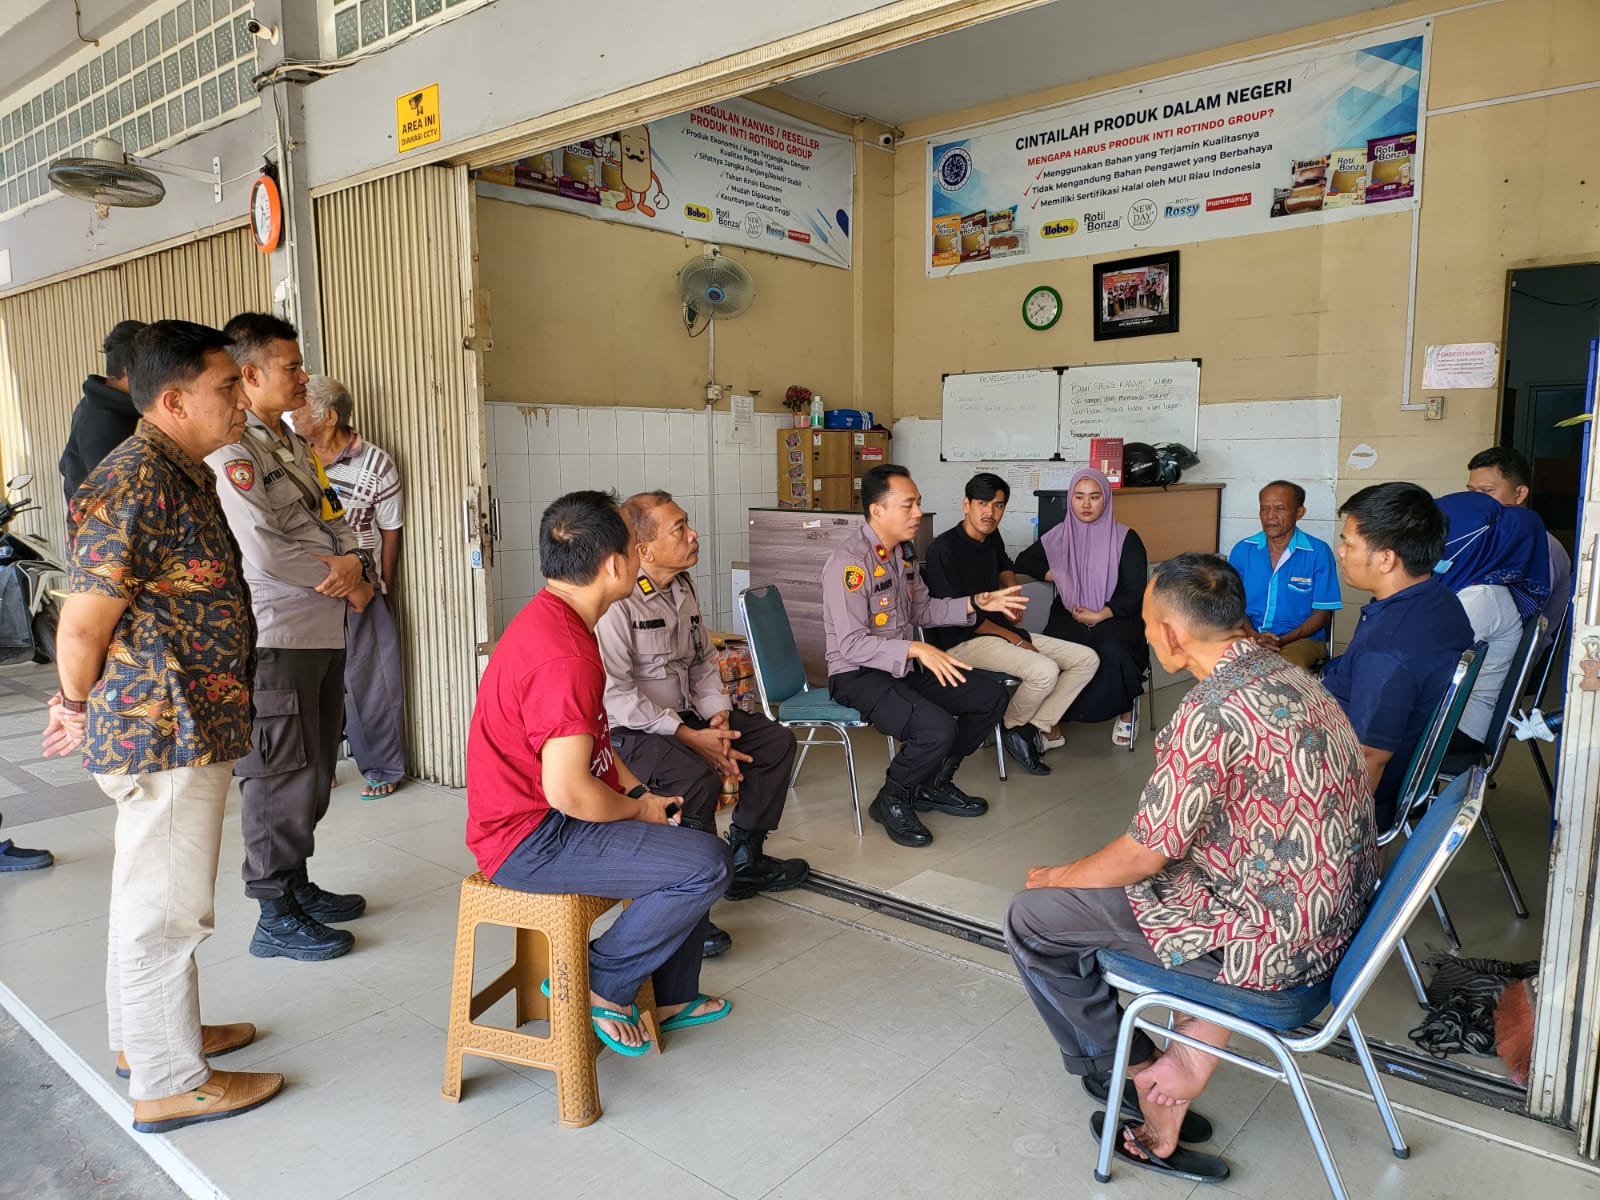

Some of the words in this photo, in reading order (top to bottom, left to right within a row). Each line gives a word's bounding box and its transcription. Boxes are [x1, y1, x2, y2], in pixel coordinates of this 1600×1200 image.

[1015, 122, 1089, 151] CINTAILAH
[1094, 107, 1158, 134] PRODUK
[1163, 93, 1221, 119] DALAM
[1226, 78, 1292, 106] NEGERI
[402, 118, 423, 135] AREA
[424, 113, 436, 127] INI
[695, 104, 740, 125] NGGULAN
[741, 115, 775, 137] KANVAS
[776, 127, 780, 138] /
[781, 129, 820, 150] RESELLER
[423, 127, 438, 139] CCTV
[690, 113, 728, 135] PRODUK
[729, 125, 747, 140] INTI
[749, 132, 785, 152] ROTINDO
[786, 143, 813, 160] GROUP
[1027, 150, 1072, 167] MENGAPA
[1073, 142, 1107, 157] HARUS
[1109, 133, 1150, 149] PRODUK
[1152, 129, 1174, 141] INTI
[1176, 118, 1225, 136] ROTINDO
[1228, 108, 1275, 126] GROUP?
[686, 128, 709, 142] Produk
[710, 135, 739, 151] Ekonomis
[743, 146, 760, 157] Harga
[760, 150, 791, 167] Terjangkau
[790, 160, 811, 172] Dengan
[1043, 161, 1103, 179] Menggunakan
[1104, 155, 1133, 168] Bahan
[1134, 150, 1158, 164] yang
[1160, 141, 1200, 157] Terjamin
[1202, 130, 1260, 148] Kualitasnya
[1375, 143, 1395, 155] Roti
[1378, 148, 1409, 161] Bonza
[699, 151, 724, 166] Sifatnya
[720, 147, 743, 161] Kualitas
[744, 154, 764, 167] Produk
[765, 160, 784, 173] Terbaik
[1337, 156, 1355, 165] Roti
[1032, 183, 1054, 195] Tidak
[1055, 173, 1112, 191] Mengandung
[1113, 167, 1142, 180] Bahan
[1144, 157, 1191, 173] Pengawet
[1192, 153, 1217, 166] yang
[1220, 142, 1273, 160] Berbahaya
[1339, 163, 1366, 172] Bonza
[725, 171, 743, 183] Tahan
[743, 177, 759, 188] Krisis
[1040, 195, 1075, 207] Memiliki
[1076, 185, 1120, 201] Sertifikasi
[1121, 180, 1144, 193] Halal
[1146, 178, 1166, 189] oleh
[1168, 173, 1187, 185] MUI
[1188, 169, 1210, 182] Riau
[1212, 161, 1261, 177] Indonesia
[731, 184, 751, 197] Mudah
[751, 190, 782, 204] Dipasarkan
[720, 192, 755, 208] Keuntungan
[755, 202, 774, 213] Cukup
[774, 204, 791, 216] Tinggi
[1132, 203, 1154, 214] NEW
[1163, 203, 1200, 218] Rossy
[686, 205, 707, 219] Bobo
[715, 207, 730, 219] Roti
[1083, 211, 1104, 223] Roti
[1133, 212, 1152, 222] DAY
[718, 216, 740, 229] Bonza
[1042, 223, 1070, 236] Bobo
[1087, 219, 1119, 232] Bonza
